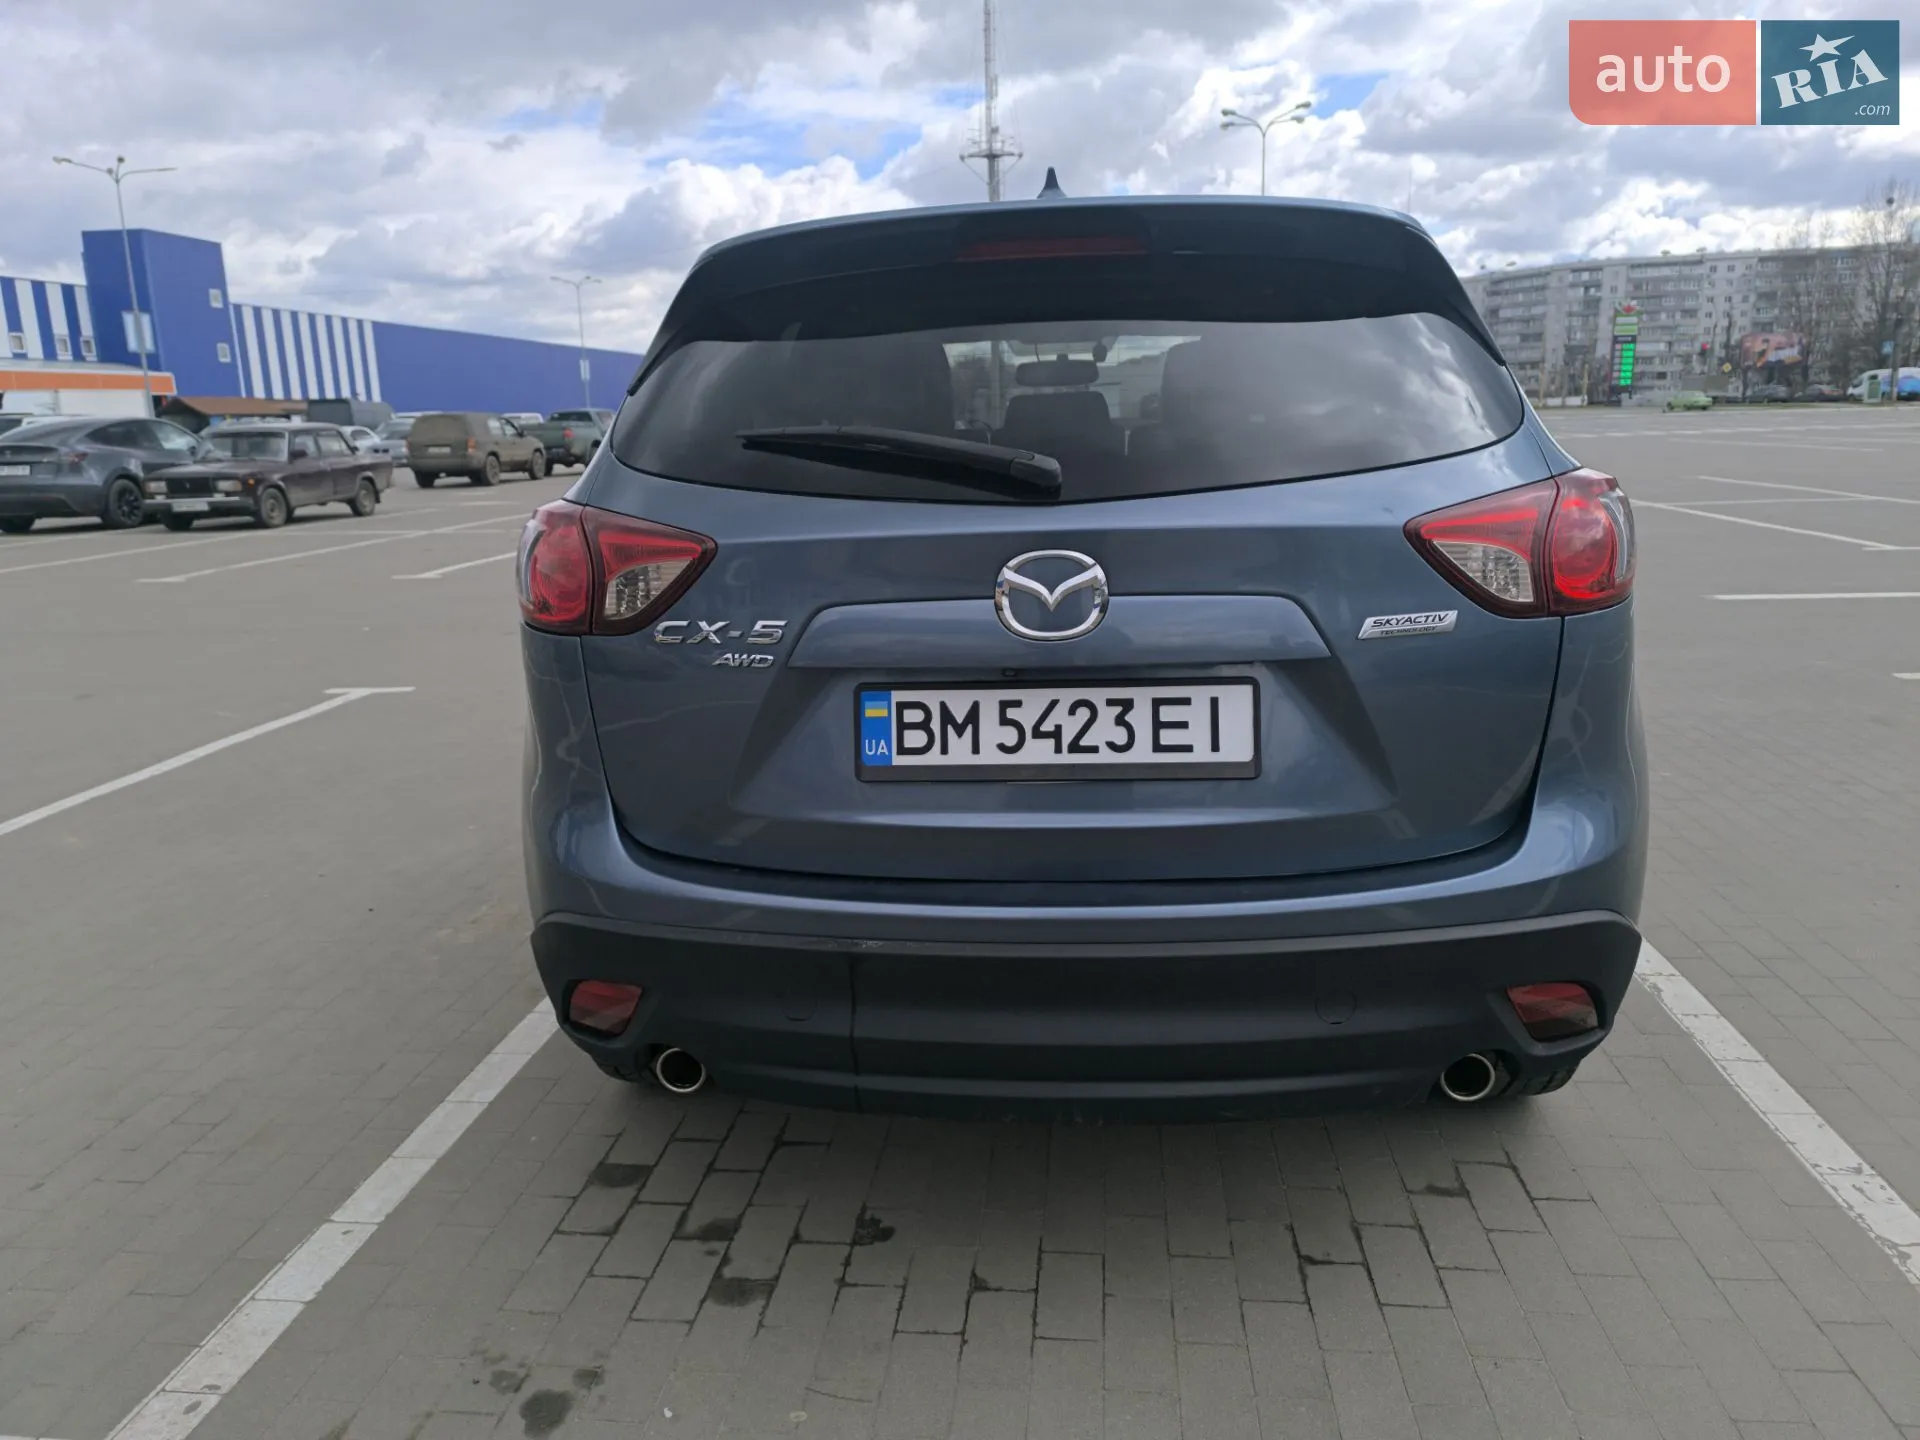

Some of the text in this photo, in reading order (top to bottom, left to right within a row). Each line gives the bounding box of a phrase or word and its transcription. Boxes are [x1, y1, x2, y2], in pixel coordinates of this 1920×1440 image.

[1371, 613, 1449, 628] SKYACTIV
[653, 619, 789, 645] CX-5
[711, 652, 775, 668] AWD
[865, 739, 889, 756] UA
